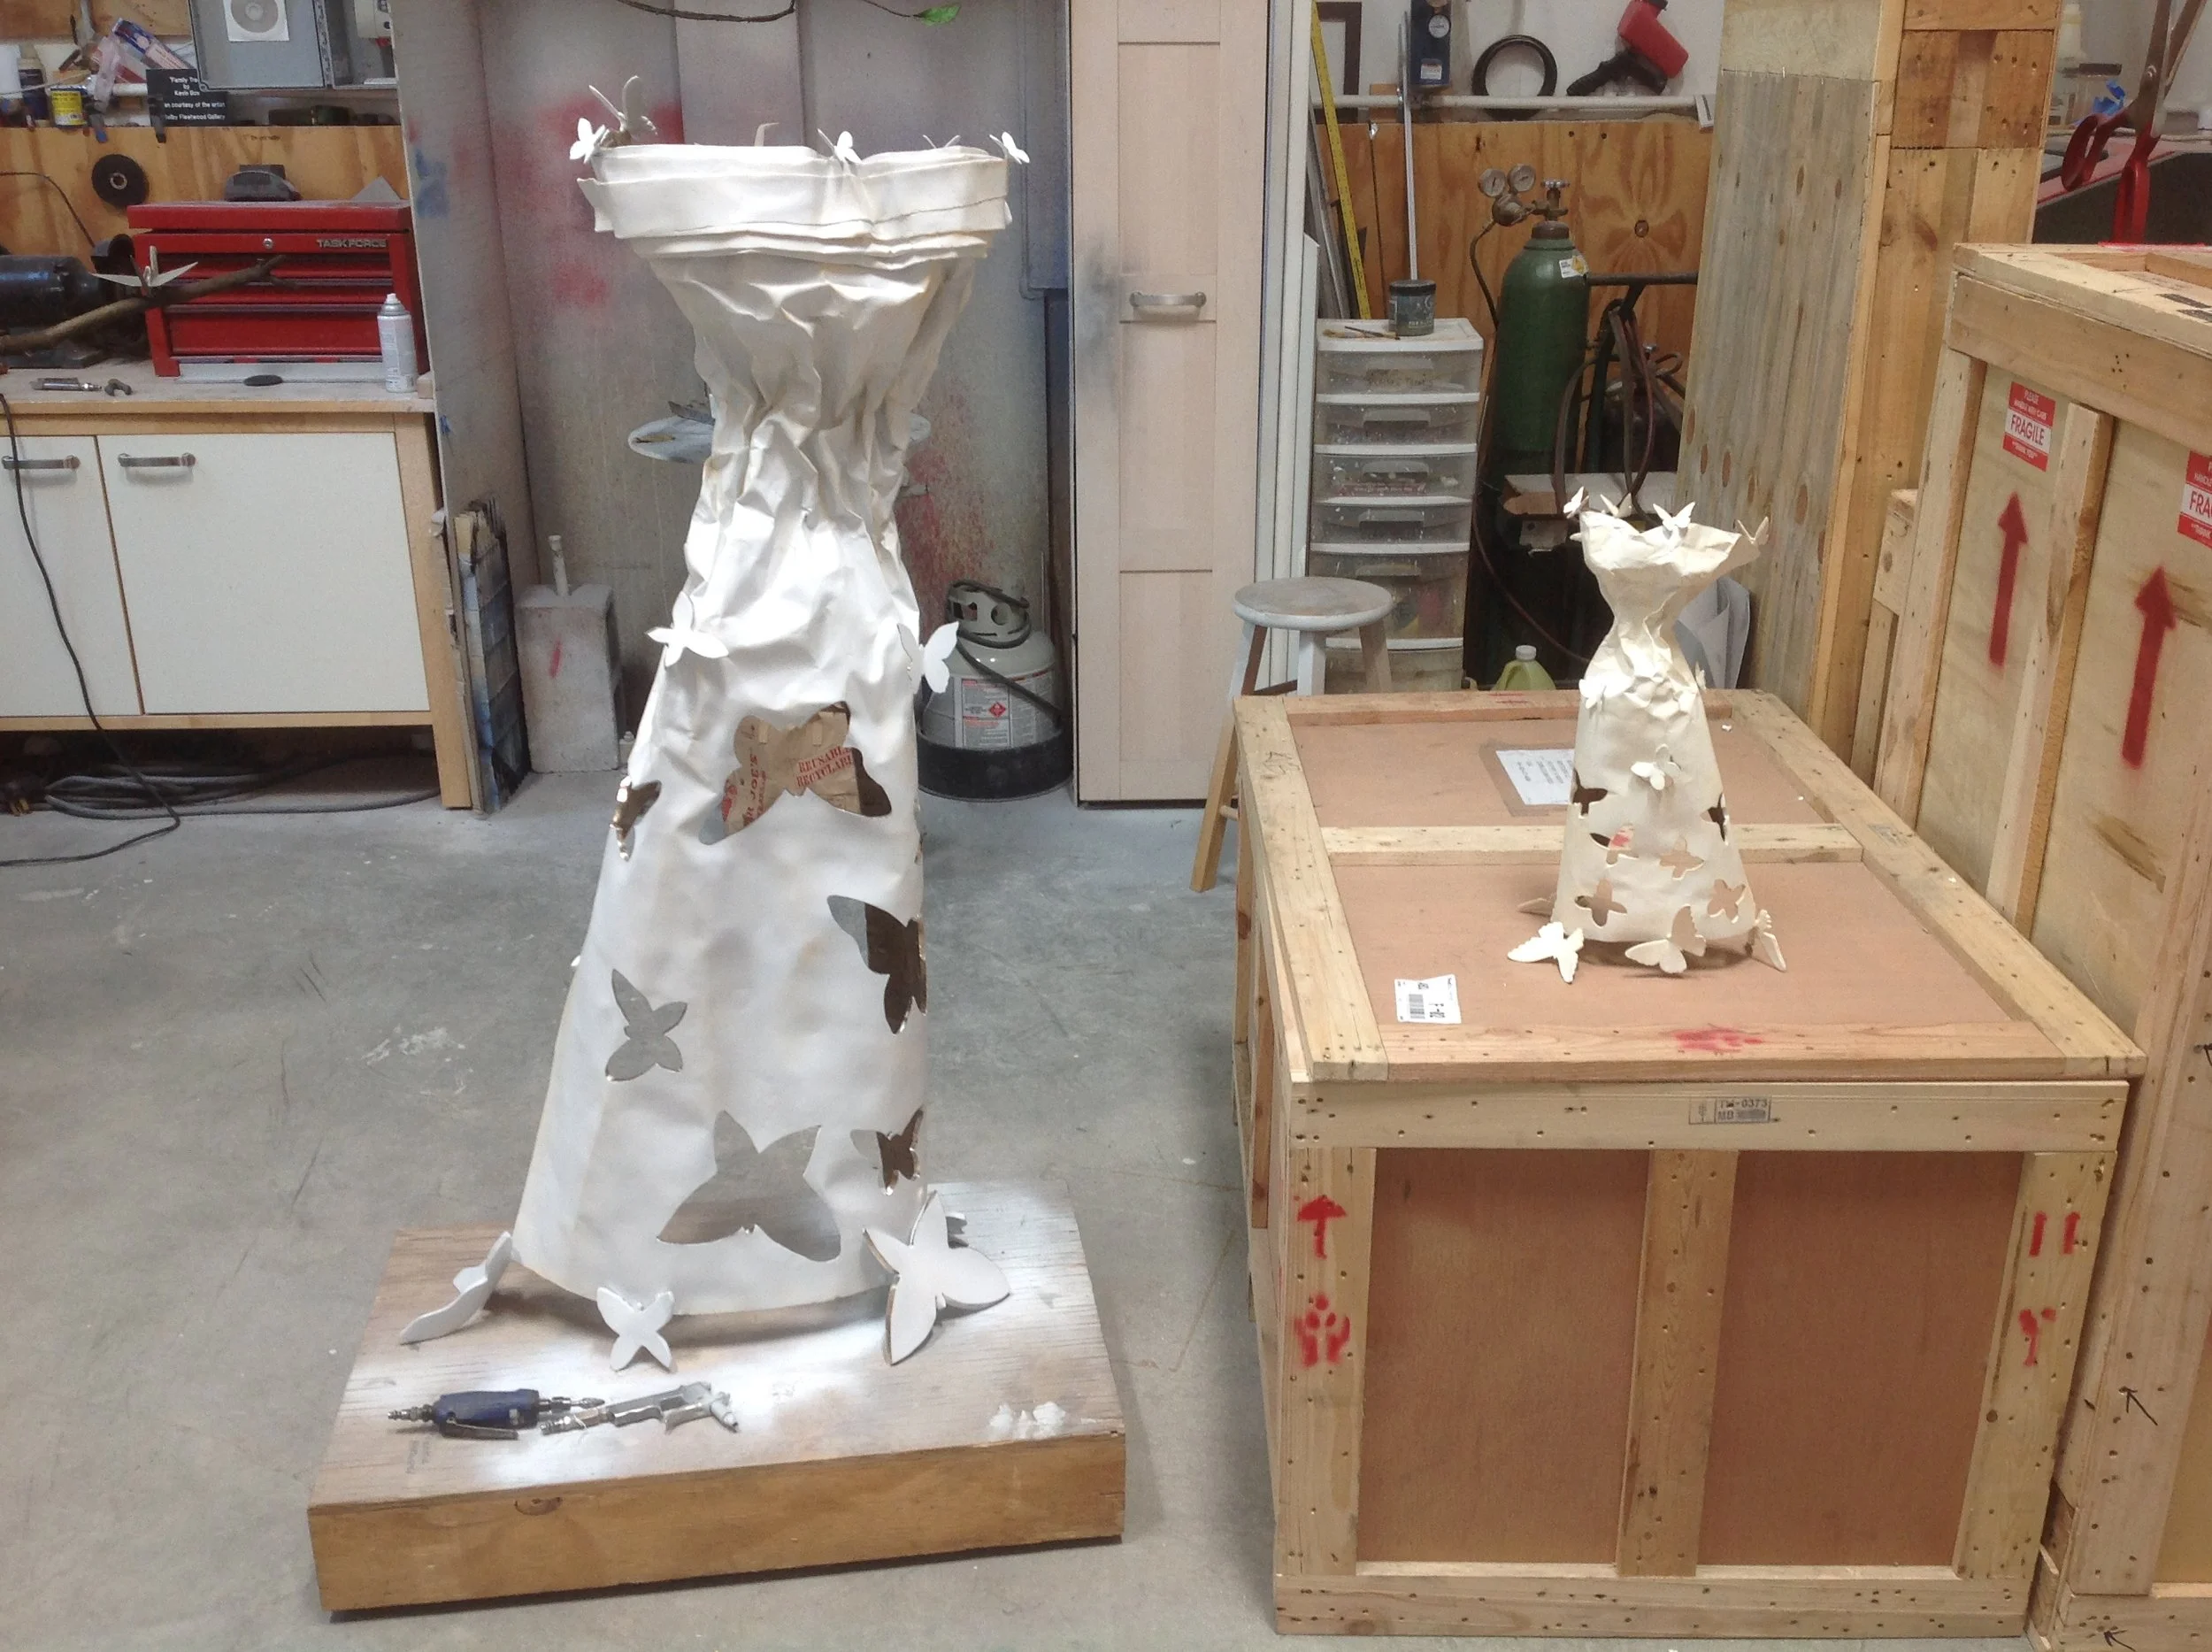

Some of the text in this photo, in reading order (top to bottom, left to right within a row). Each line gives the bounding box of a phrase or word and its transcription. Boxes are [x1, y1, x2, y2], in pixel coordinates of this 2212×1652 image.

[2010, 414, 2045, 446] FRAGILE
[2189, 490, 2212, 519] FRA
[796, 755, 852, 788] RECYCLABL
